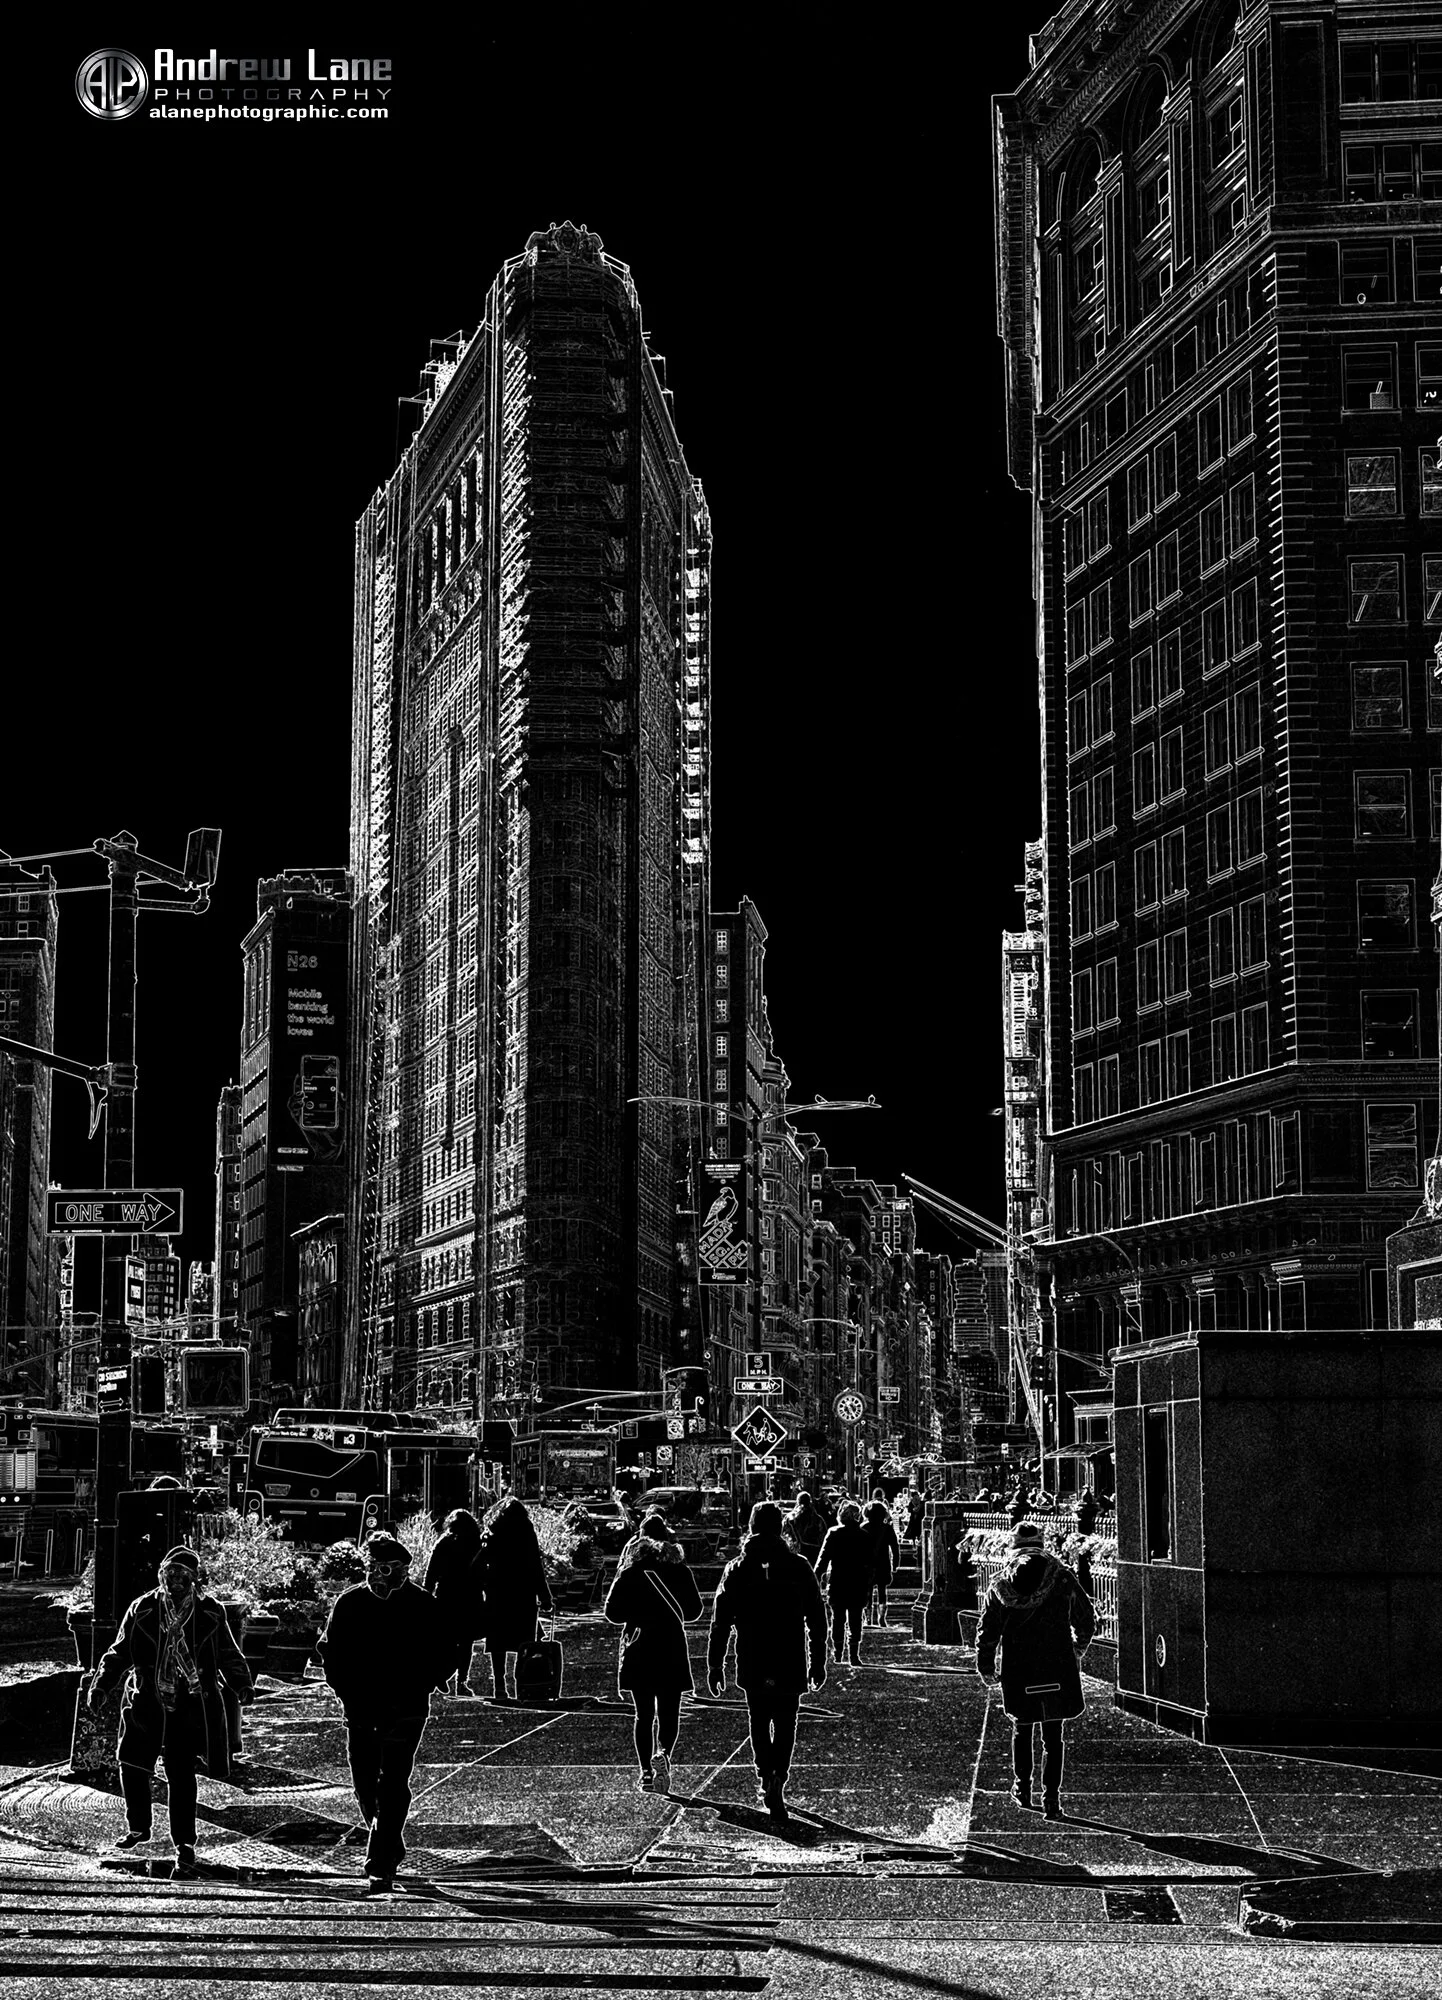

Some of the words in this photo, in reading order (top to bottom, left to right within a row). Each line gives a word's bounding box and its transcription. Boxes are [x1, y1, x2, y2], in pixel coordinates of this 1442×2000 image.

[287, 988, 322, 998] Mobile
[287, 1000, 328, 1014] banking
[287, 1013, 304, 1024] the
[306, 1015, 335, 1025] world
[65, 1204, 104, 1221] ONE
[121, 1204, 162, 1221] WAY
[753, 1355, 764, 1369] 5
[741, 1382, 755, 1390] ONE
[761, 1382, 775, 1390] WAY
